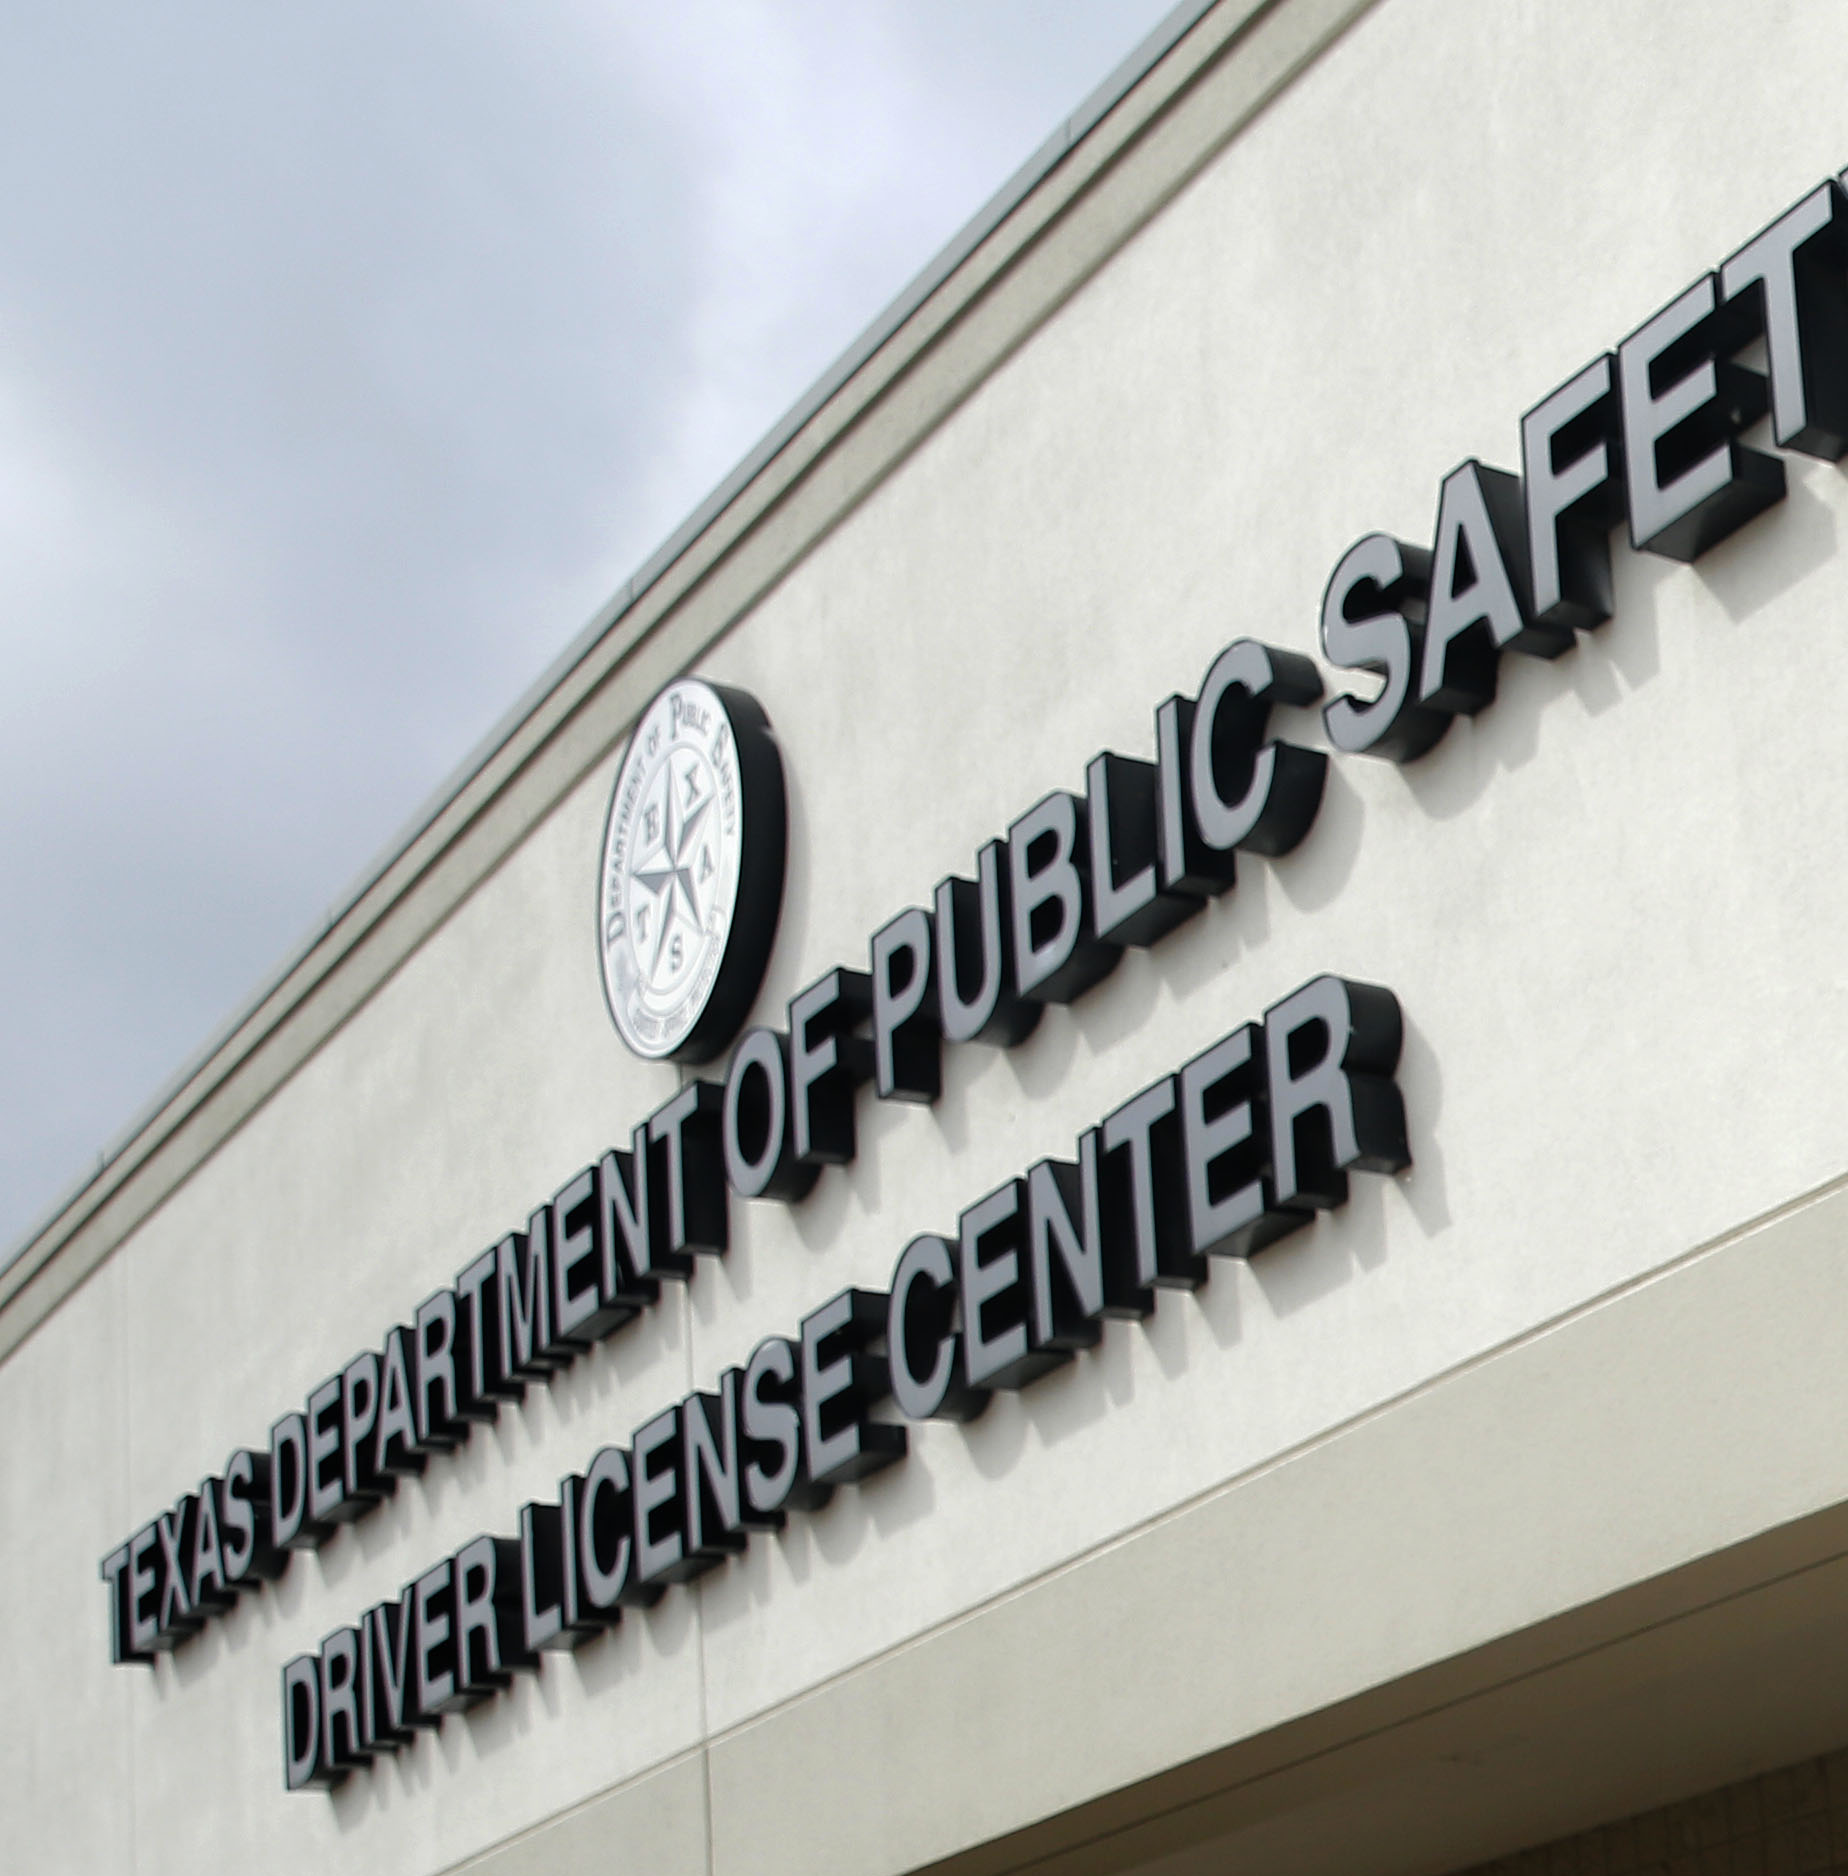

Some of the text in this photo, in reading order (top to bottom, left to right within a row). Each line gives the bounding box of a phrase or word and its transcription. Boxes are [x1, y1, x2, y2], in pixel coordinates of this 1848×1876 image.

[100, 1450, 275, 1662] TEXAS
[271, 1080, 722, 1548] DEPARTMENT
[724, 966, 864, 1200] OF
[872, 640, 1320, 1104] PUBLIC
[282, 974, 1408, 1790] DRIVER LICENSE CENTER
